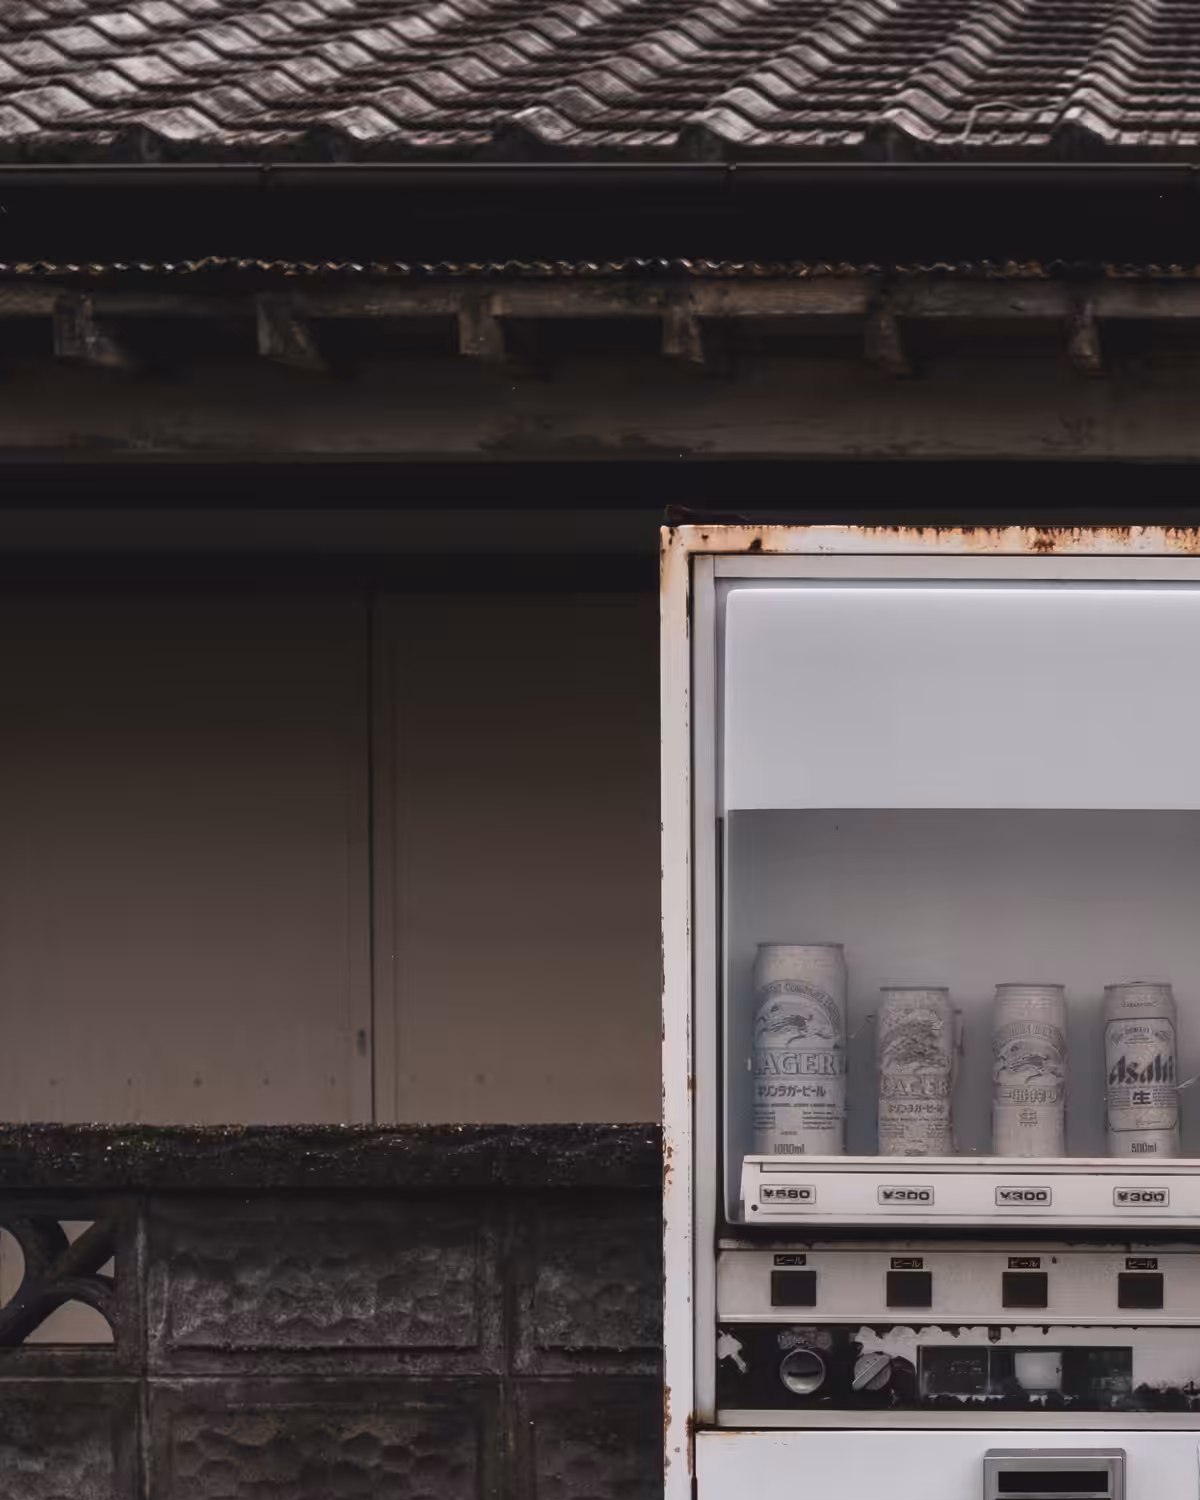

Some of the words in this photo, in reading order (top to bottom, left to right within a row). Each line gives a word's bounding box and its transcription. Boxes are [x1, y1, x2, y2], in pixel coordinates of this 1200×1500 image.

[1109, 1054, 1174, 1085] Asahi
[1132, 1090, 1152, 1105] 生
[763, 1188, 811, 1200] ¥580
[882, 1190, 930, 1202] ¥300
[1000, 1190, 1048, 1202] ¥300
[1118, 1191, 1166, 1203] ¥300
[776, 1255, 805, 1265] ビール
[892, 1258, 922, 1268] ビール
[1009, 1258, 1038, 1268] ビール
[1127, 1258, 1157, 1269] ビール
